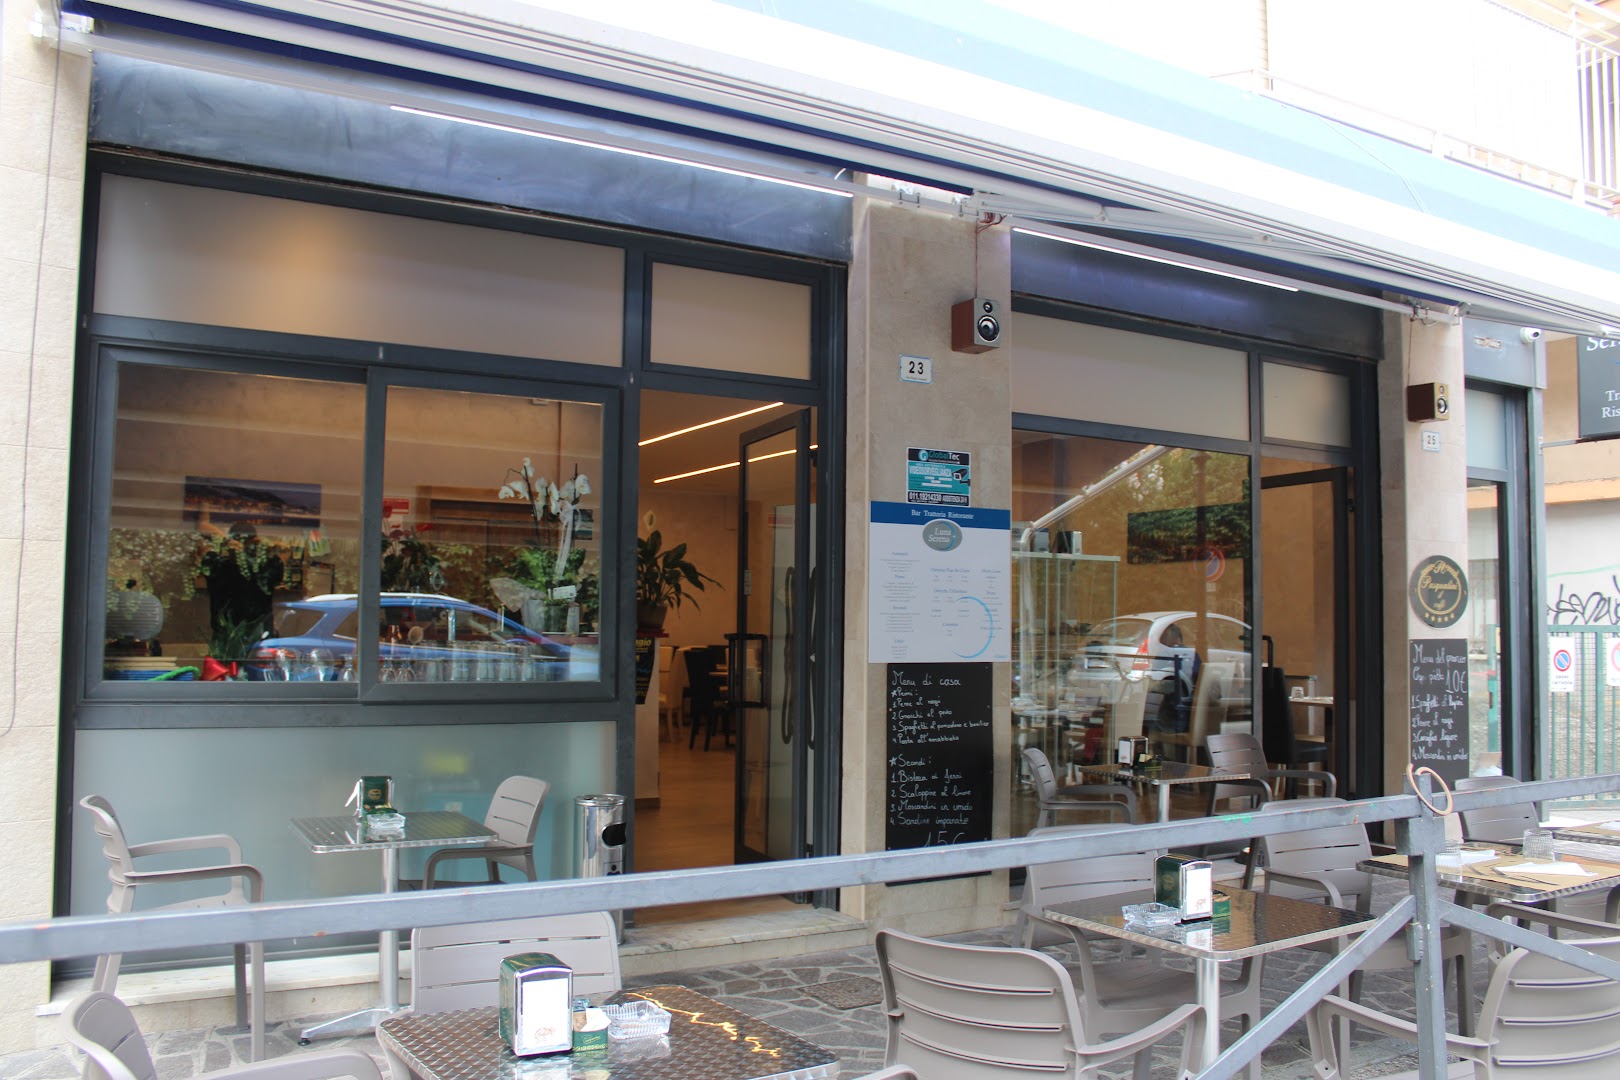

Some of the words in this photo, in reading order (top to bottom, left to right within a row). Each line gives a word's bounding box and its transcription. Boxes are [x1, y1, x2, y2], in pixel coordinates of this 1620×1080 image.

[1586, 336, 1620, 351] Ser
[908, 360, 924, 375] 23
[1605, 390, 1620, 402] Tr
[1427, 434, 1436, 445] 25
[923, 510, 946, 518] Trattoria
[948, 512, 974, 520] Ristorante
[934, 527, 951, 536] Luna
[928, 535, 950, 543] Serena
[892, 670, 916, 686] Menu
[922, 673, 932, 686] di
[939, 678, 961, 686] casa
